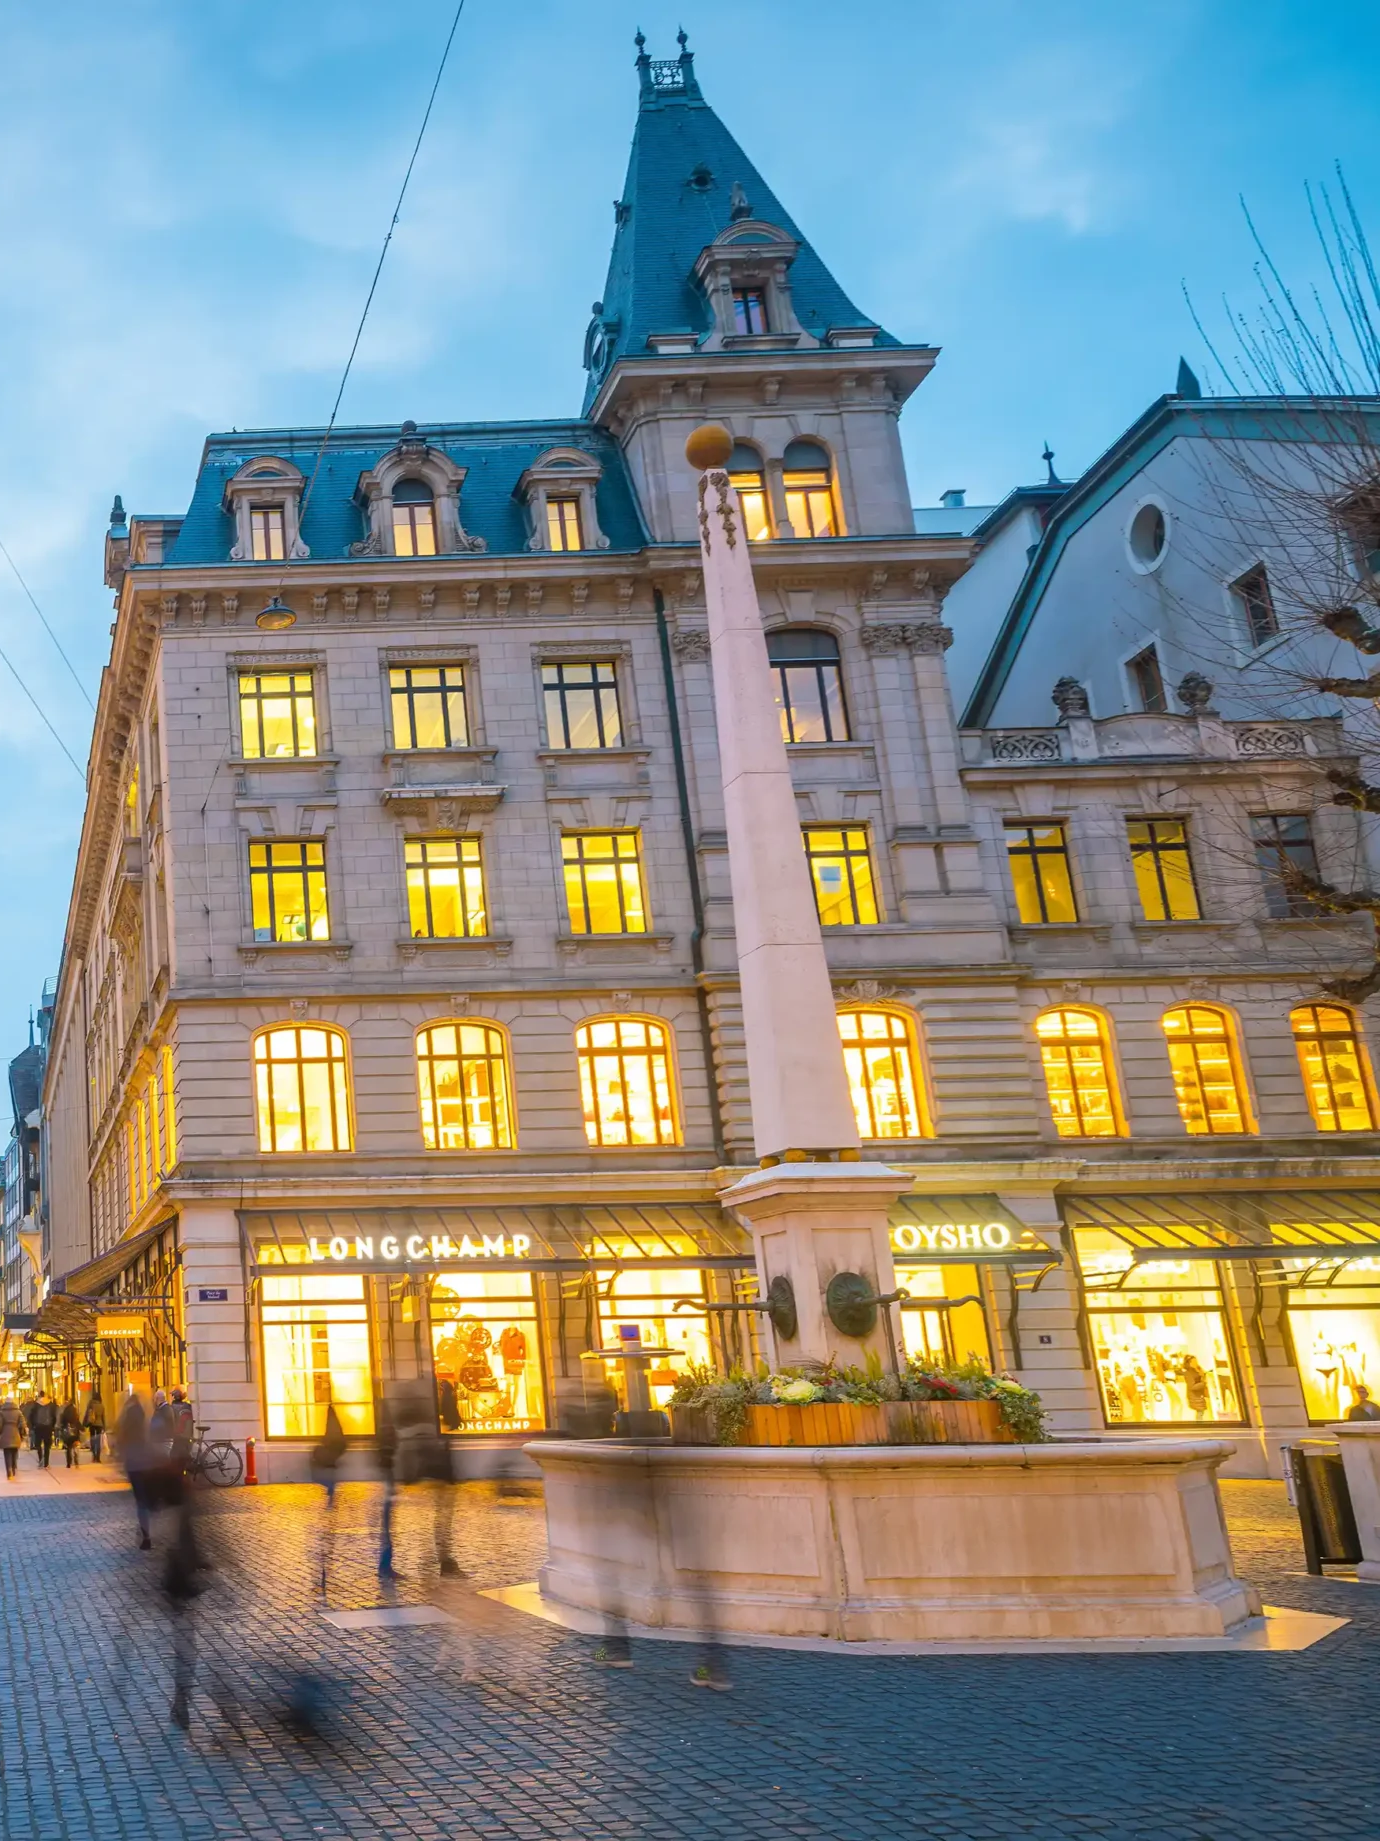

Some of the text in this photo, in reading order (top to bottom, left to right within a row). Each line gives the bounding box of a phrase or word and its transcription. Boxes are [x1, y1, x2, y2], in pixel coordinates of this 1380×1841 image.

[893, 1223, 1011, 1249] OYSHO
[309, 1234, 531, 1260] LONGCHAMP
[28, 1353, 56, 1361] GLOBUS
[457, 1420, 531, 1432] ONGCHAMP
